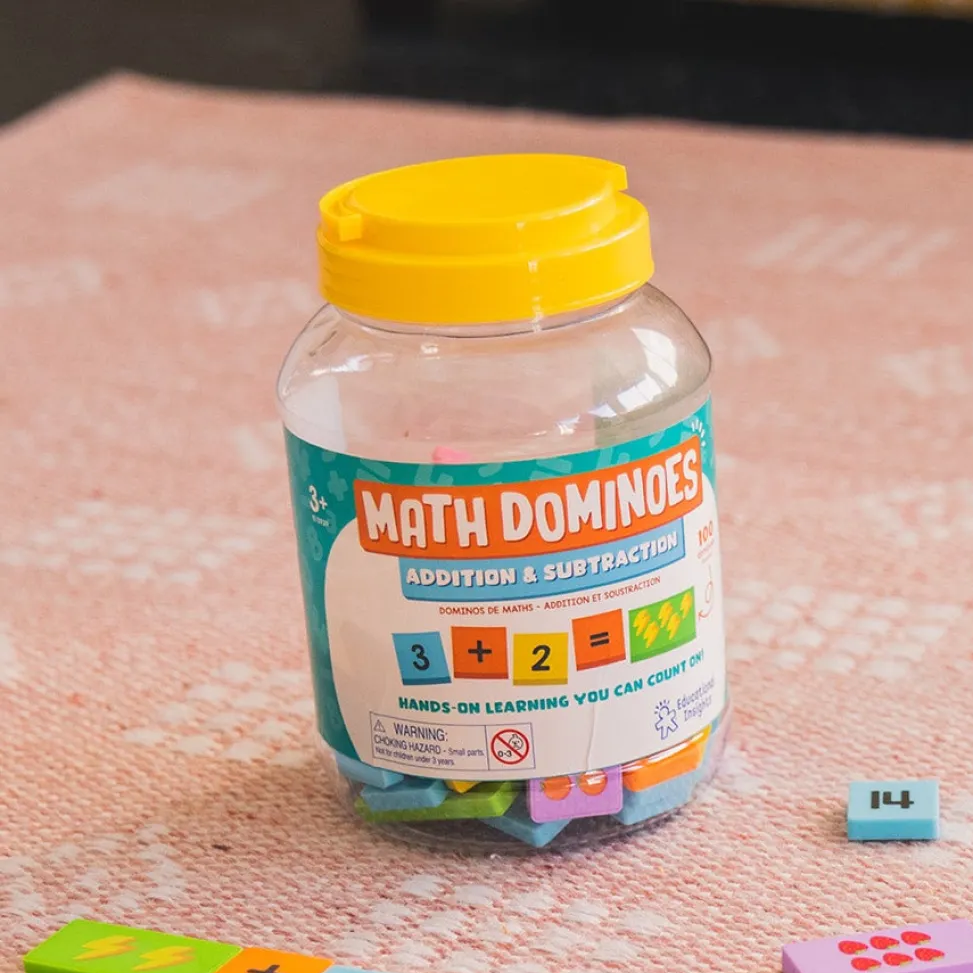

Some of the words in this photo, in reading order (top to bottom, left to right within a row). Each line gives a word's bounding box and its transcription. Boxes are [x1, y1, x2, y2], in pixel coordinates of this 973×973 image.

[308, 485, 328, 513] 3+
[361, 490, 489, 549] MATH
[500, 448, 700, 543] DOMINOES
[405, 567, 517, 588] ADDITION
[522, 566, 538, 584] &
[543, 531, 679, 581] SUBTRACTION
[439, 606, 486, 616] DOMINOS
[487, 605, 500, 615] DE
[502, 603, 534, 614] MATHS
[543, 595, 590, 611] ADDITION
[592, 593, 602, 603] ET
[603, 576, 661, 600] SOUSTRACTION
[410, 643, 431, 671] 3
[531, 644, 551, 671] 2
[398, 696, 480, 714] HANDS-ON
[486, 694, 569, 714] LEARNING
[574, 689, 610, 706] YOU
[614, 677, 643, 699] CAN
[647, 660, 687, 687] COUNT
[374, 734, 407, 750] CHOKING
[409, 742, 441, 755] HAZARD
[448, 747, 466, 756] Small
[393, 722, 448, 742] WARNING:
[870, 790, 915, 809] 14
